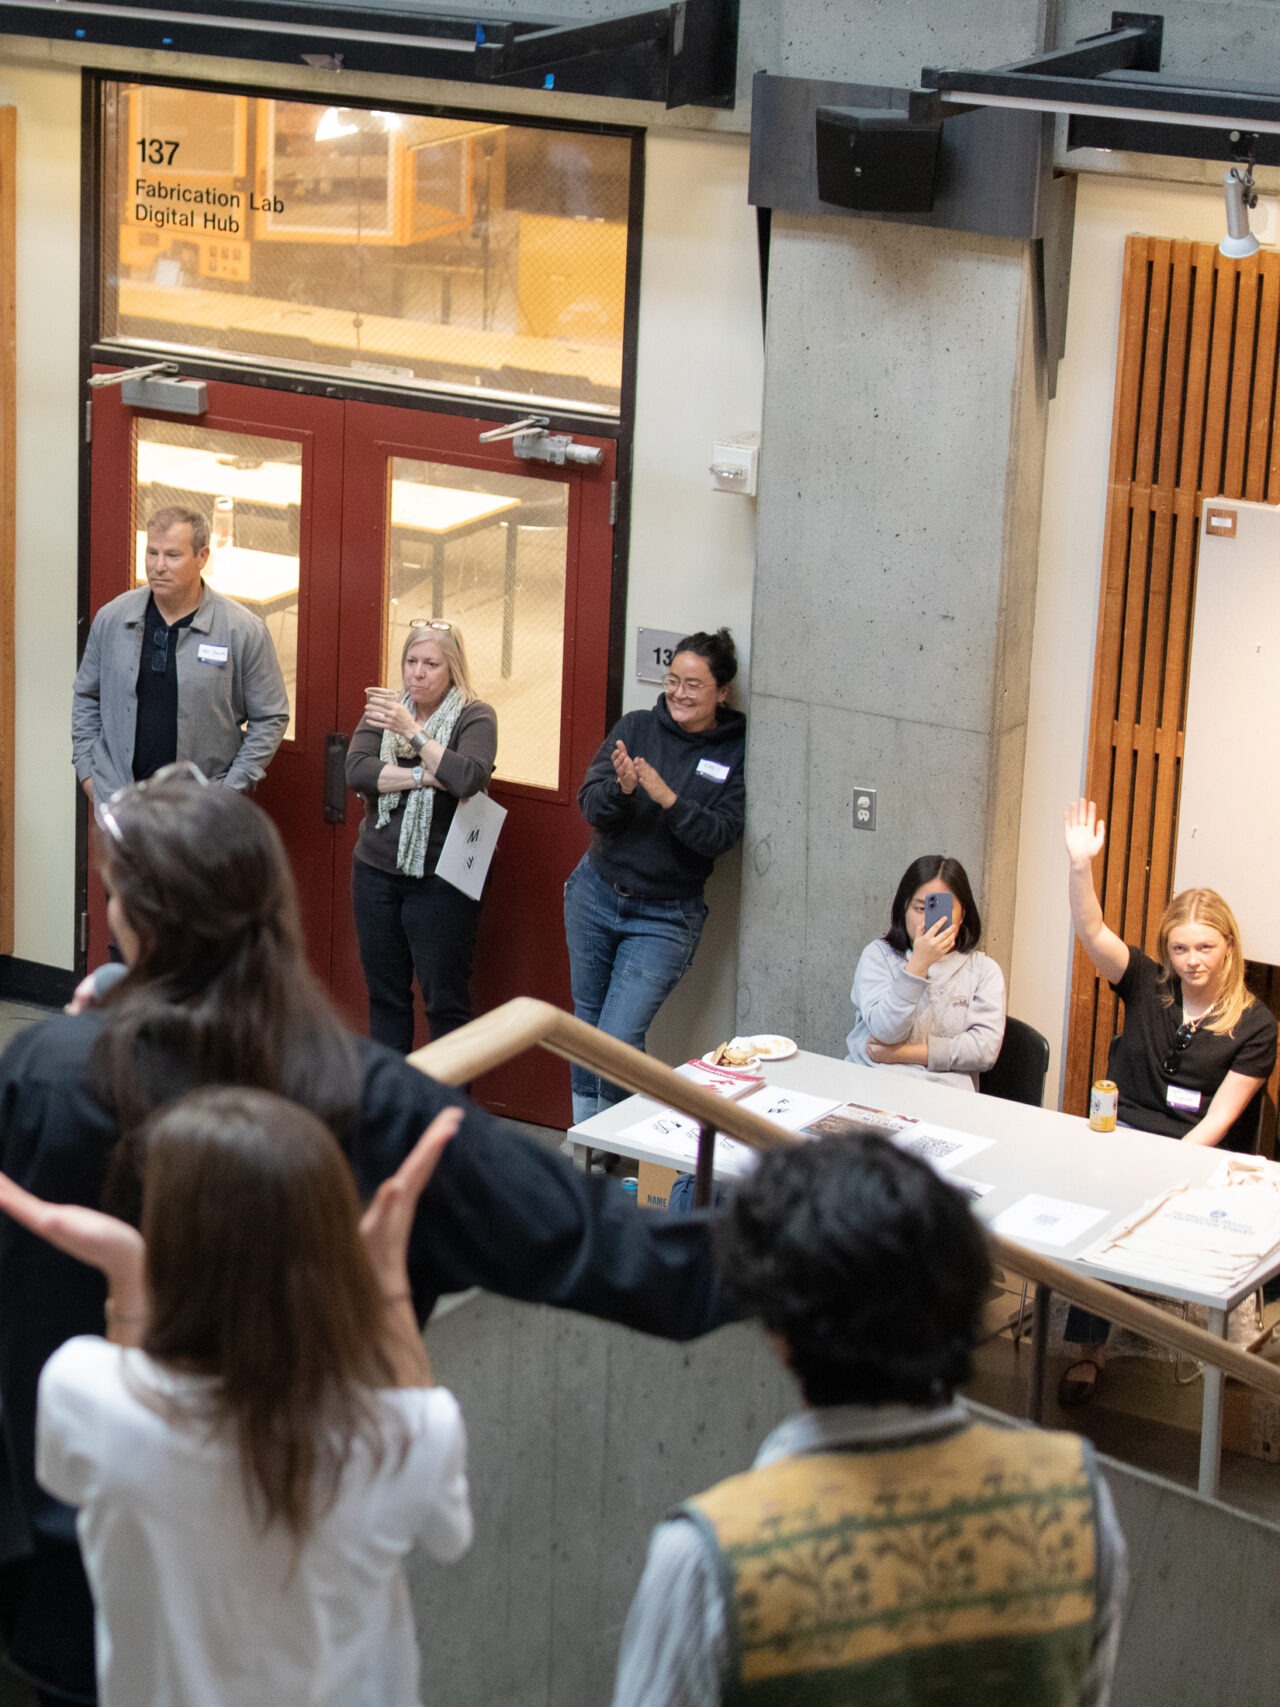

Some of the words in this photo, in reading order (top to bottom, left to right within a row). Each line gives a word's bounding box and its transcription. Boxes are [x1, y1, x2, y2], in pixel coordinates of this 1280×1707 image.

[136, 137, 180, 166] 137
[135, 179, 241, 209] Fabrication
[249, 192, 285, 214] Lab
[135, 204, 195, 229] Digital
[203, 212, 240, 234] Hub
[653, 647, 676, 667] 13
[647, 1194, 667, 1208] NAME
